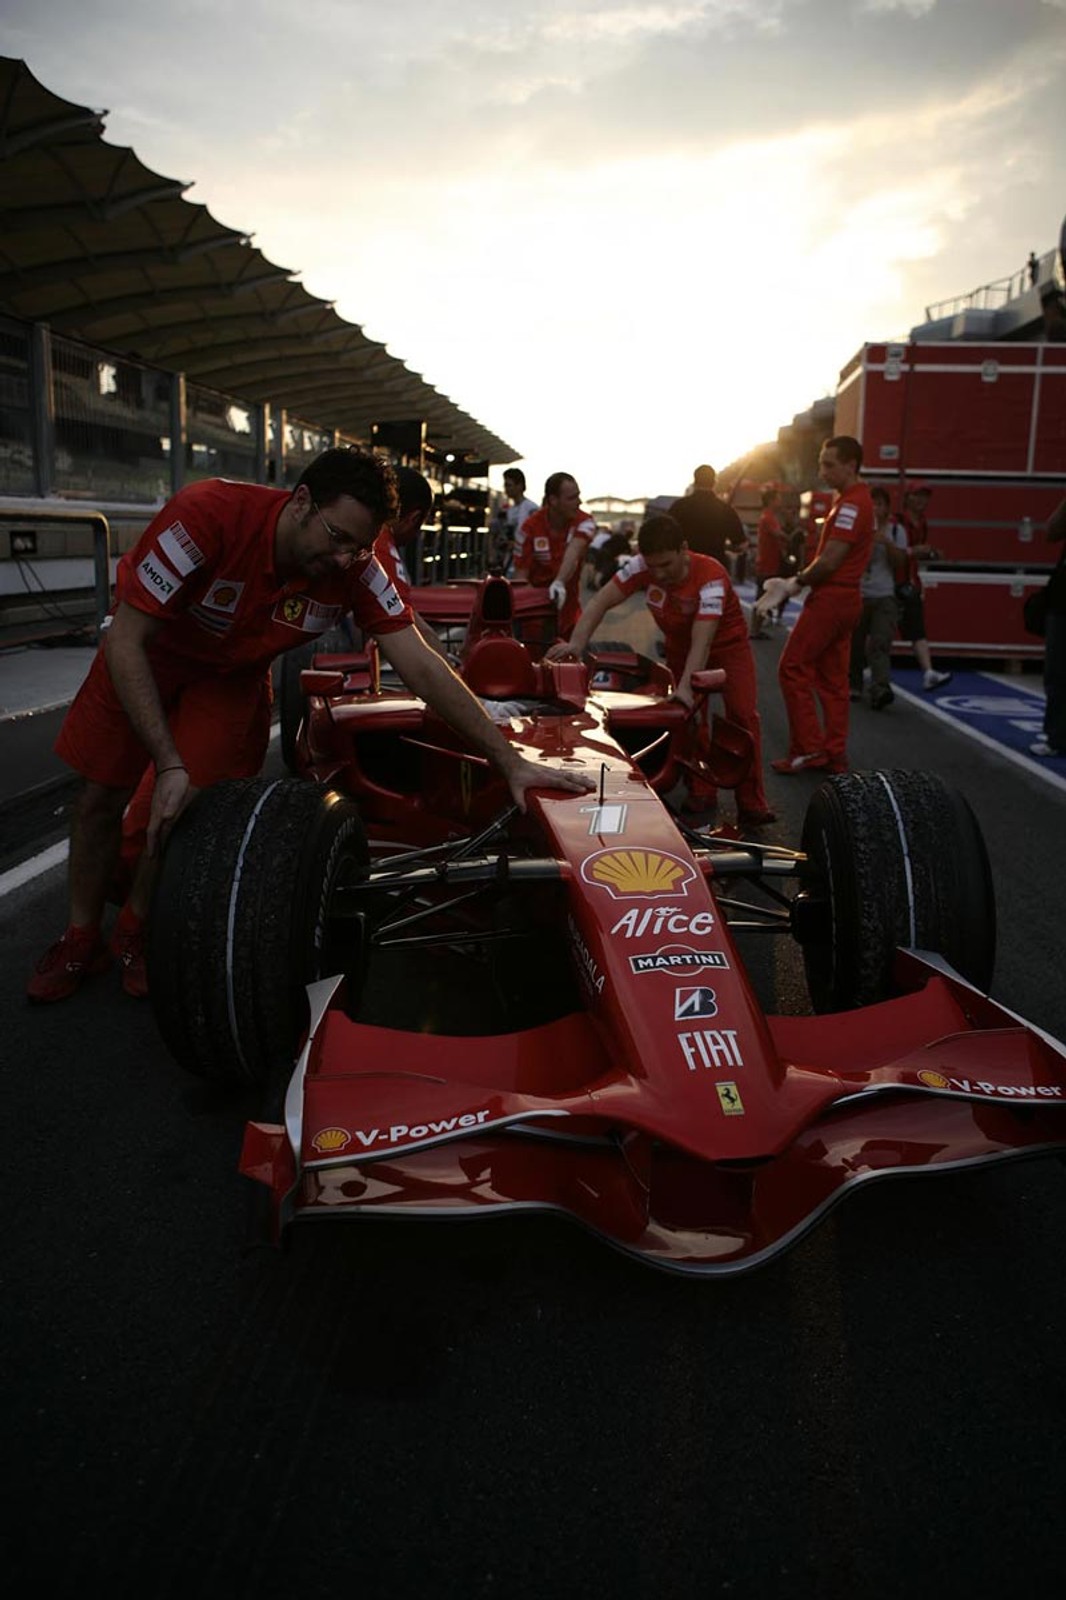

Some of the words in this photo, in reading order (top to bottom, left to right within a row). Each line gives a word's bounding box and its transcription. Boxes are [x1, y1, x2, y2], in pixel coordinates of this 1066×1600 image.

[142, 562, 164, 586] AMD
[580, 804, 627, 835] 1
[610, 907, 715, 938] Alice
[637, 954, 722, 969] MARTINI
[677, 1030, 744, 1070] FIAT
[949, 1077, 1063, 1097] V-Power
[355, 1109, 490, 1147] V-Power
